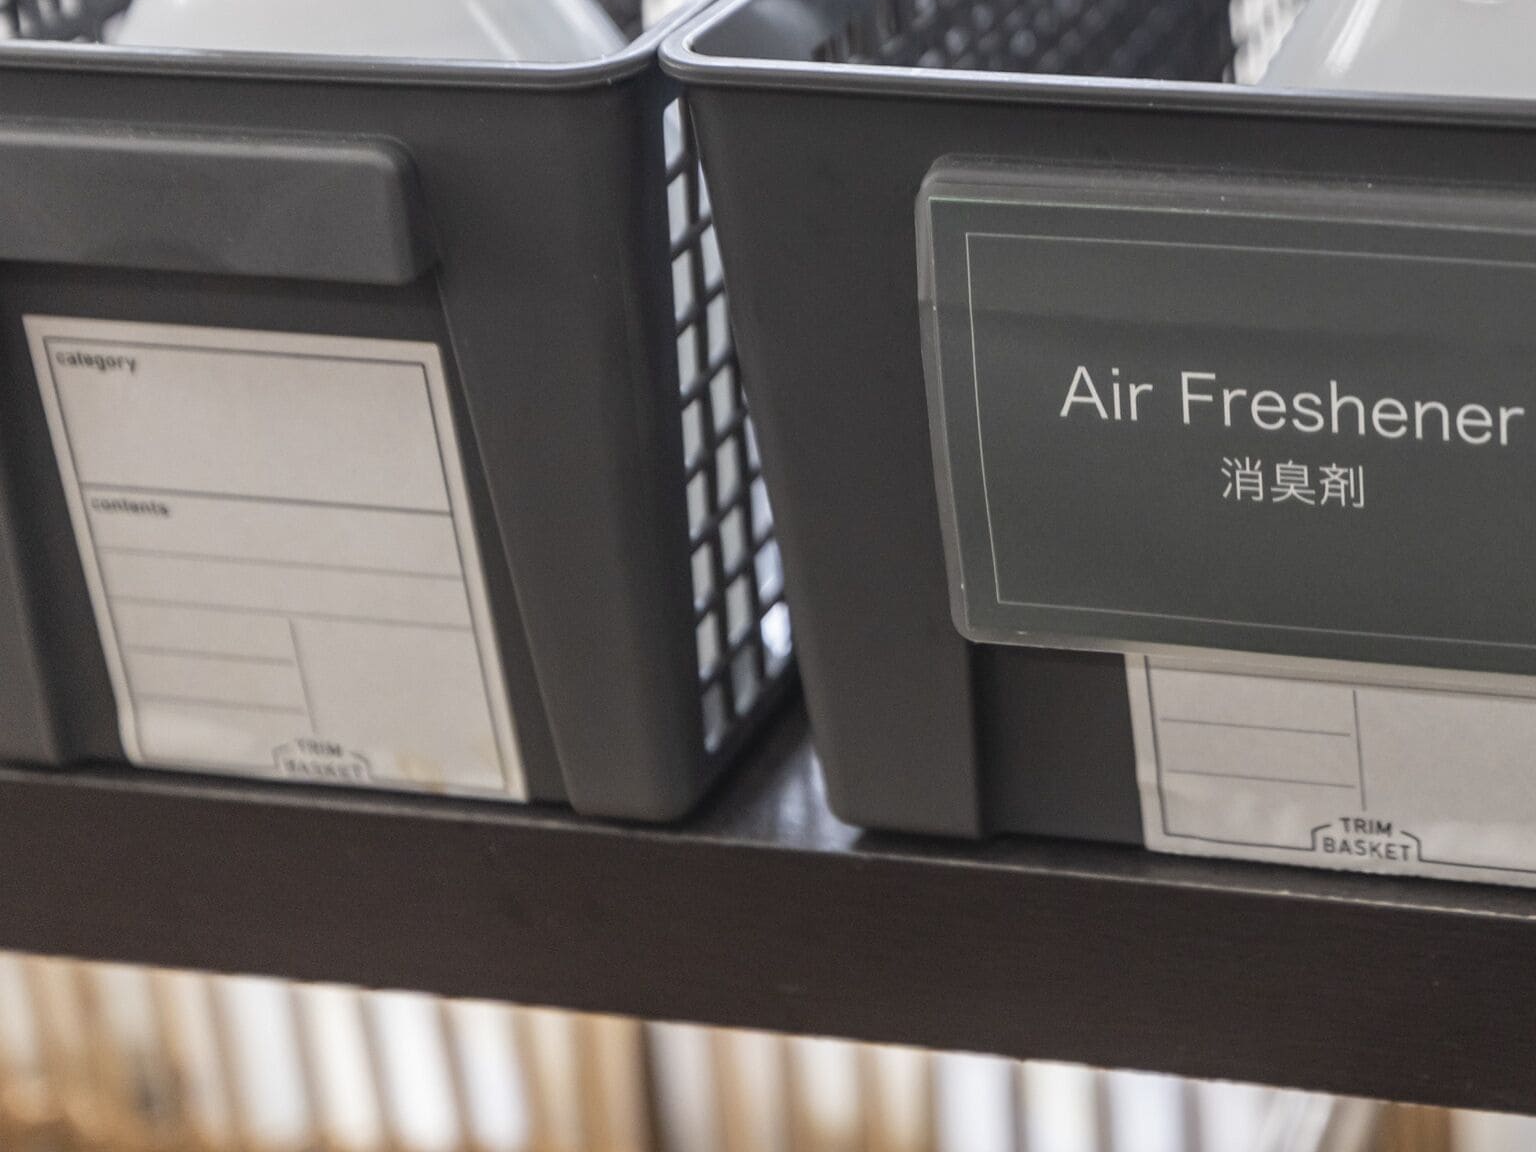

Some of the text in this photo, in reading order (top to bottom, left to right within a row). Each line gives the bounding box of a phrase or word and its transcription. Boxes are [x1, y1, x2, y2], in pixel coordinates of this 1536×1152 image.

[55, 352, 137, 373] category
[1060, 365, 1525, 446] Air Freshener
[1221, 456, 1365, 508] 消臭剤
[91, 500, 170, 518] contents
[1339, 817, 1392, 837] TRIM
[1323, 836, 1409, 861] BASKET
